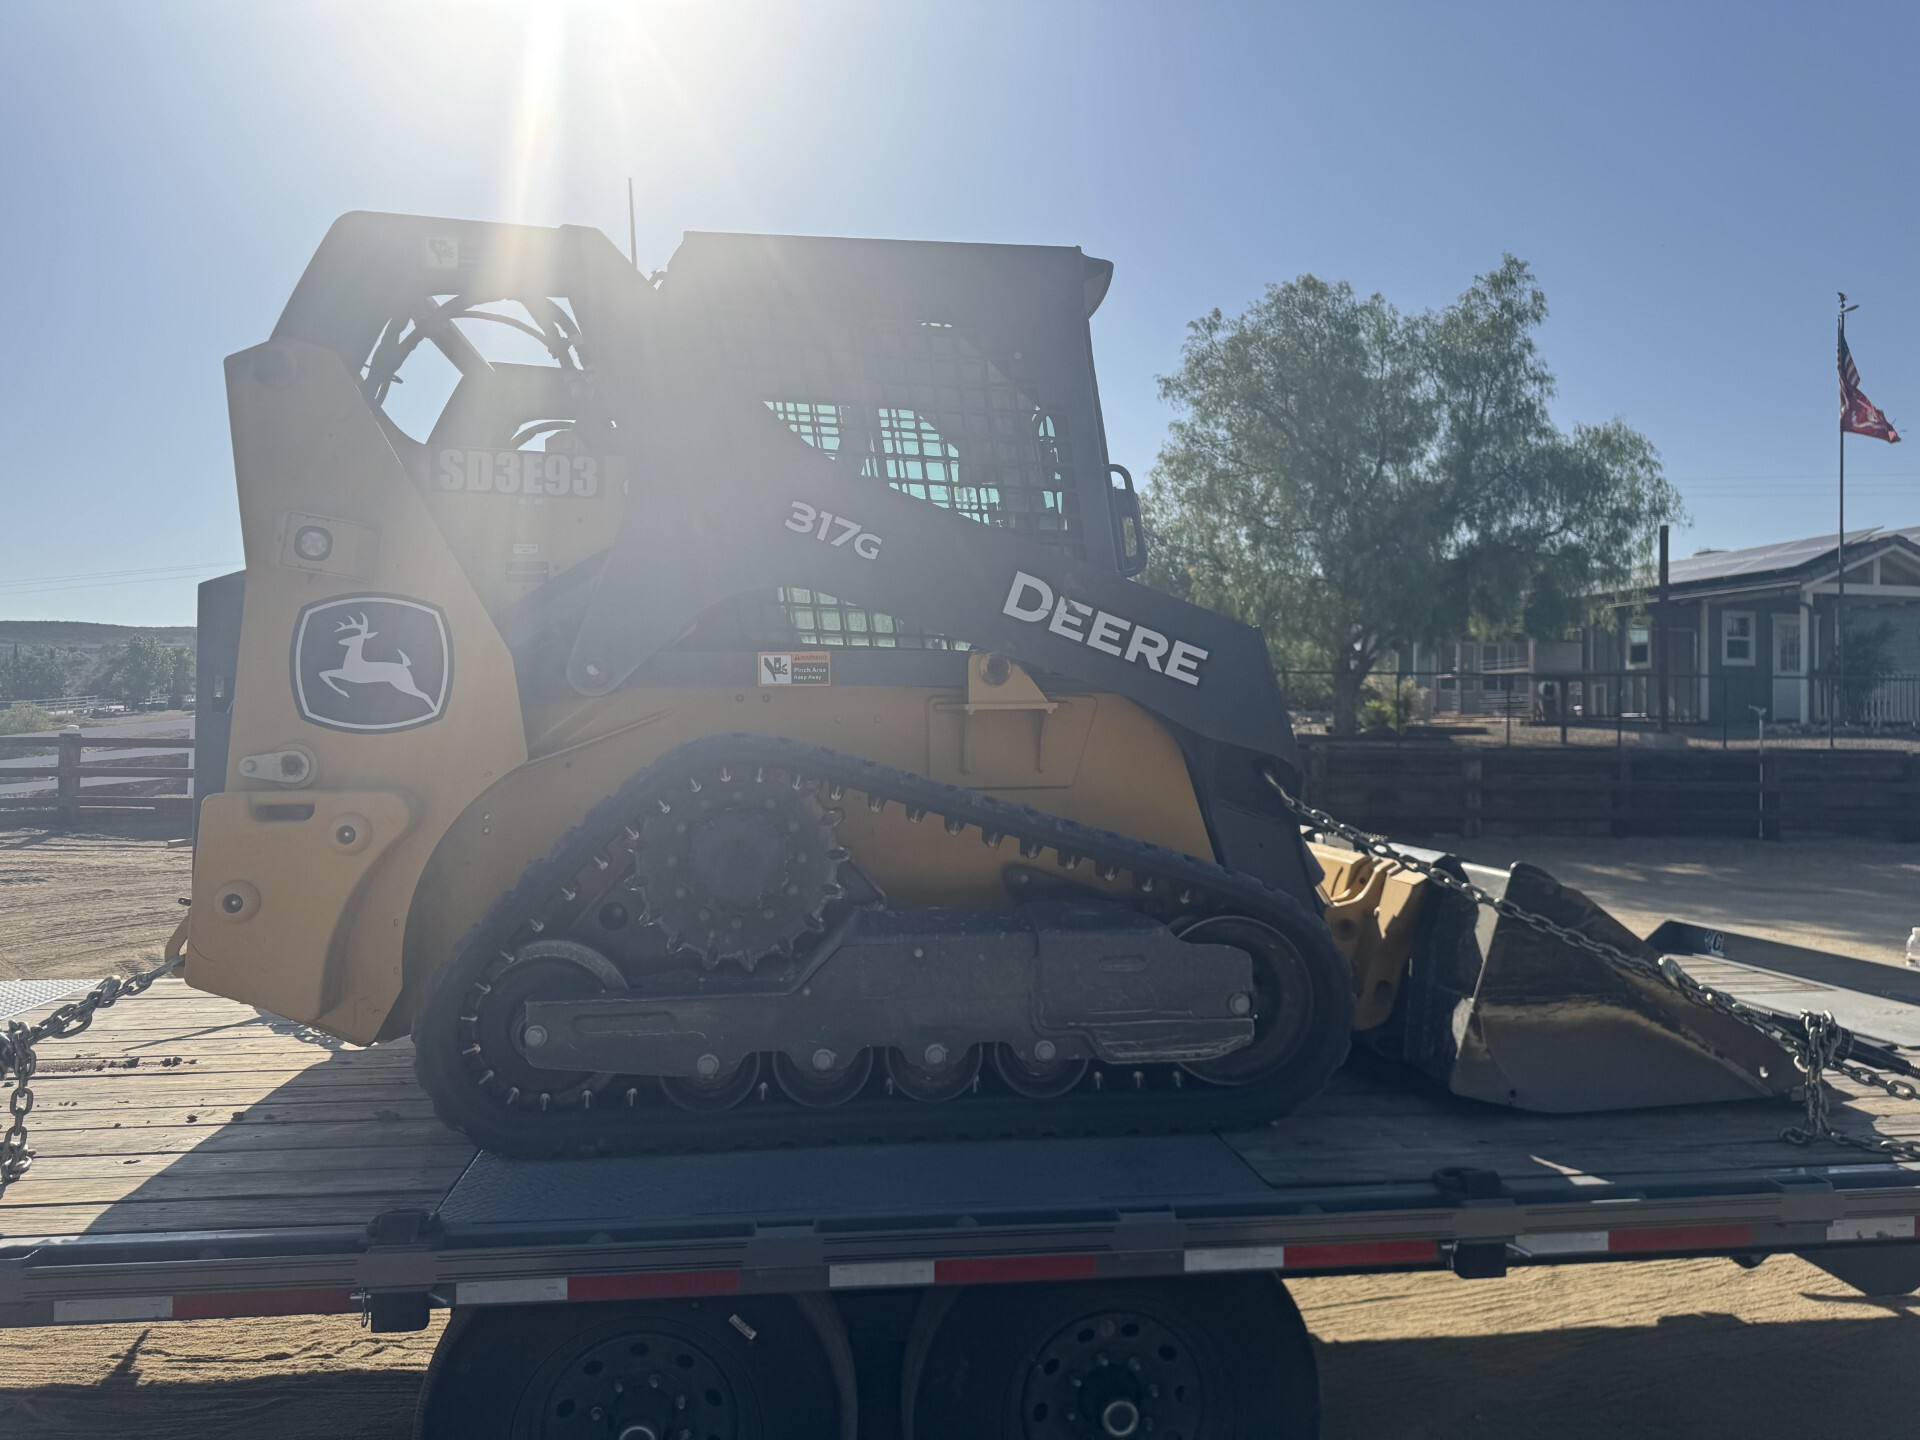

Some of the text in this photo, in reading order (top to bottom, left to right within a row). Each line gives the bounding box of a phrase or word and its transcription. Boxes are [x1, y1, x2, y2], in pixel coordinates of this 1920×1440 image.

[439, 449, 597, 497] SD3E93
[785, 502, 883, 561] 317G
[1002, 571, 1209, 686] DEERE
